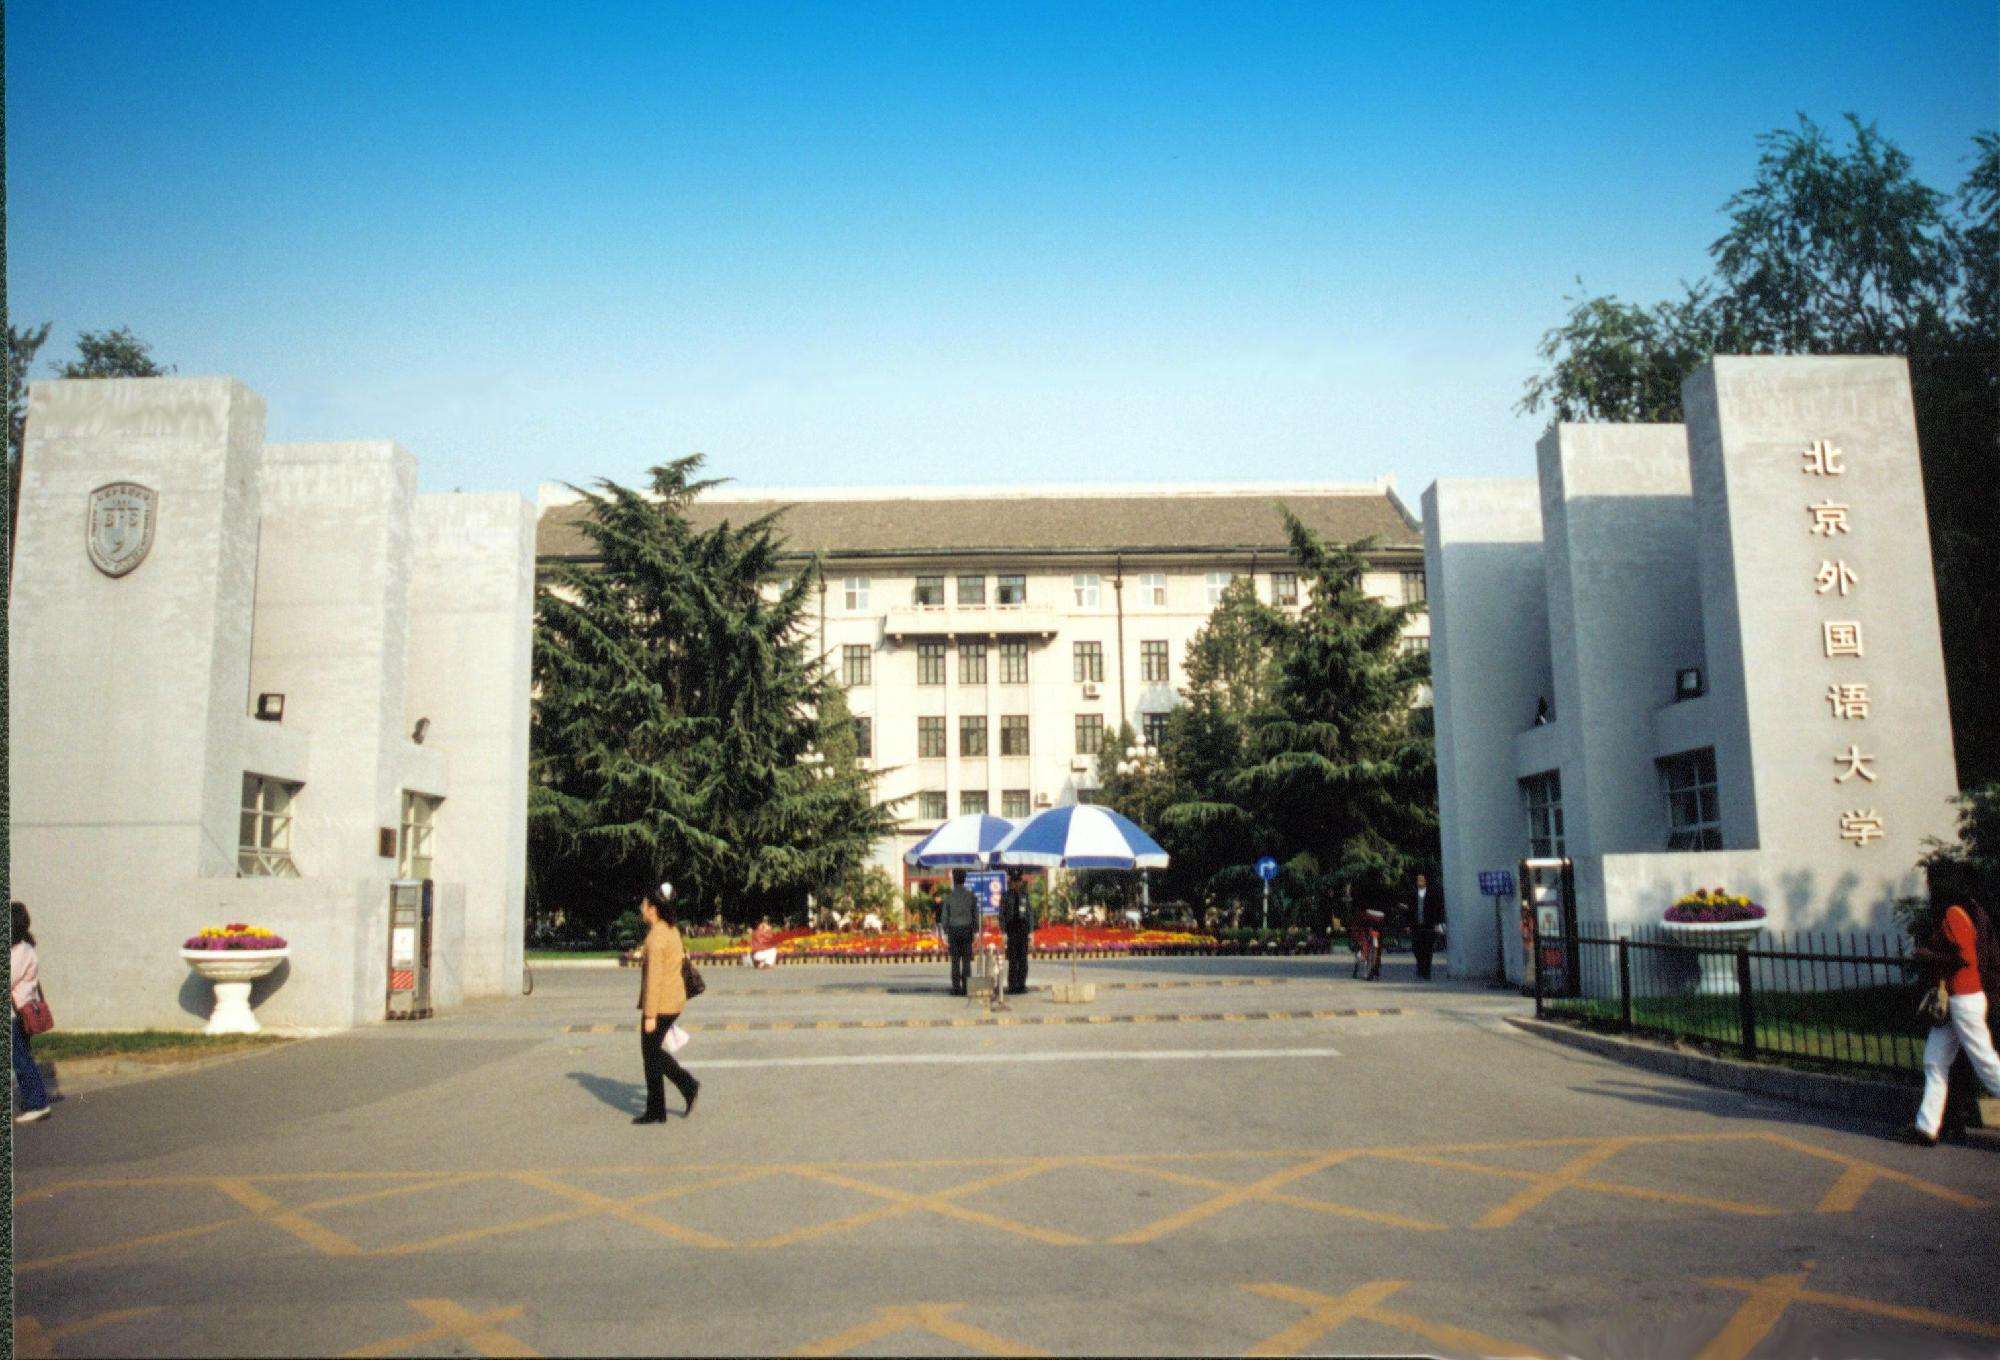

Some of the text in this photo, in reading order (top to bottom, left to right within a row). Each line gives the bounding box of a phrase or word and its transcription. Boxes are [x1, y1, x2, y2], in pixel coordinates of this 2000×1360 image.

[1803, 439, 1884, 847] 北京外国语大学
